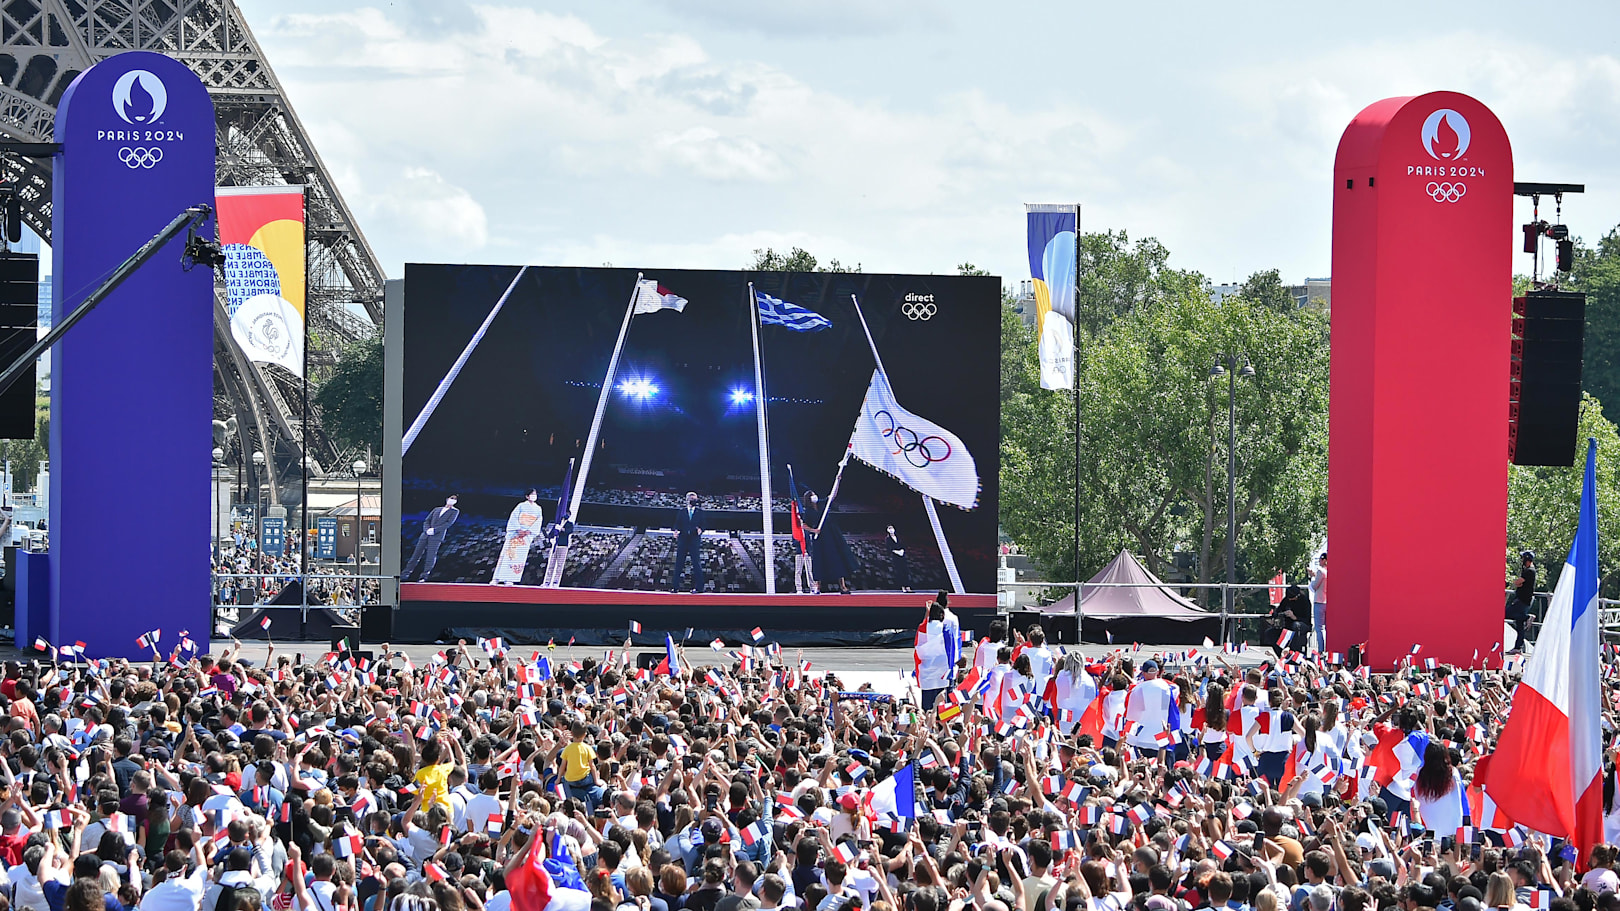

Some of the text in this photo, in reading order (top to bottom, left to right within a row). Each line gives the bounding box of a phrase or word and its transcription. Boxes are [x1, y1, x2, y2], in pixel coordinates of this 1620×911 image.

[97, 130, 184, 141] PARIS 2024
[1407, 165, 1485, 177] PARIS 2024
[905, 292, 934, 302] direct
